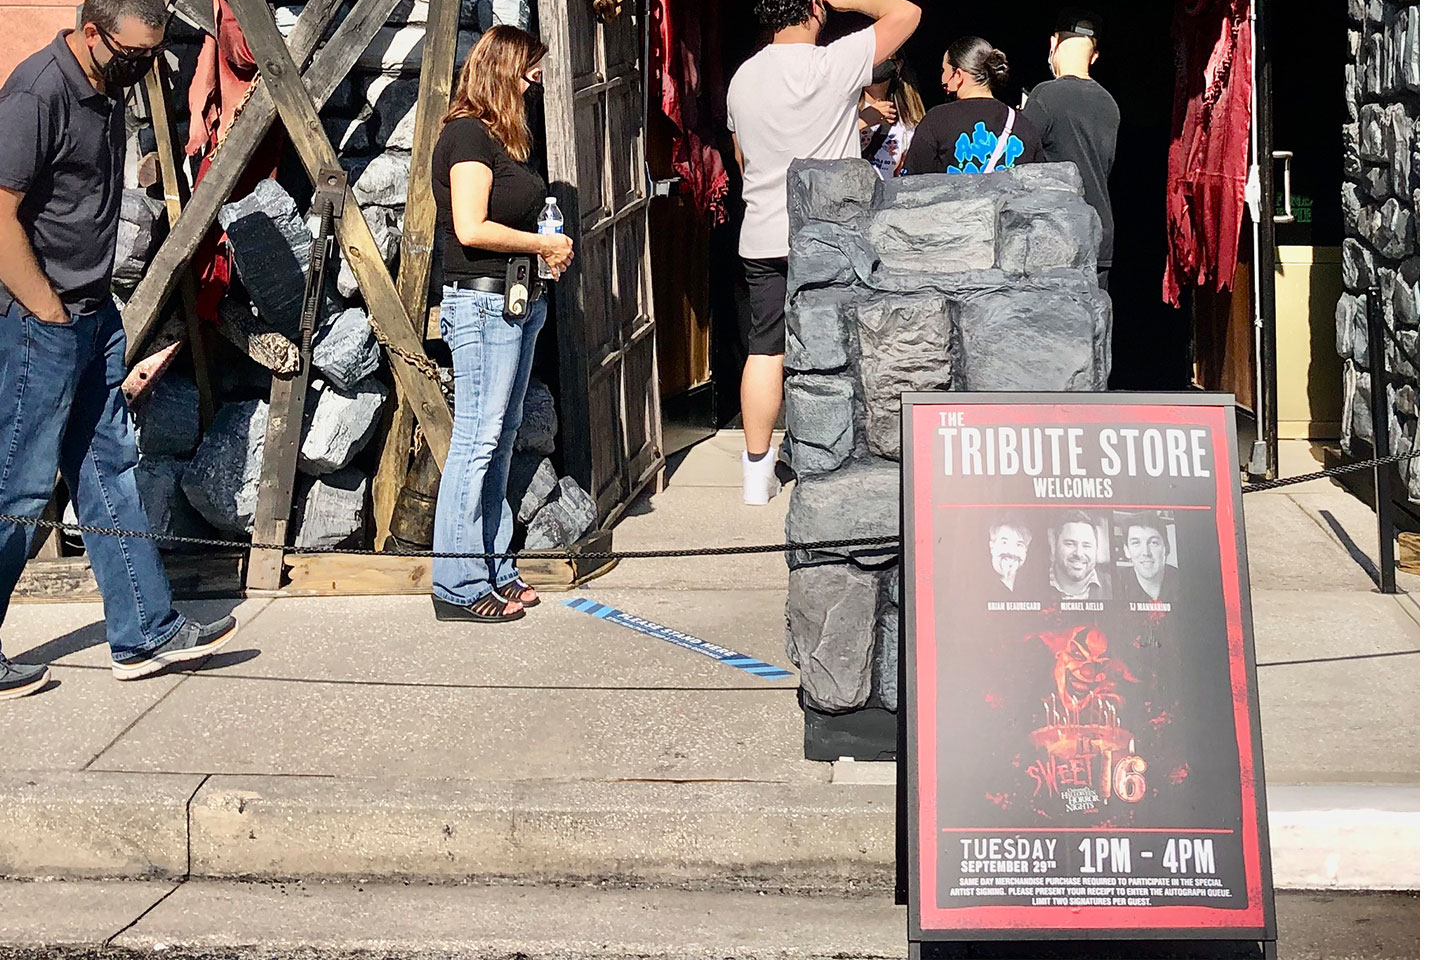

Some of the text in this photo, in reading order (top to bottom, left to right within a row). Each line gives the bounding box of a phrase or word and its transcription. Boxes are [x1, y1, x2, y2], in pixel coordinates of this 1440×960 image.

[938, 412, 965, 427] THE
[938, 428, 1211, 478] TRIBUTE STORE
[1033, 478, 1113, 499] WELCOMES
[1060, 602, 1104, 611] MICHAEL AIELLO
[1129, 602, 1137, 611] TJ
[617, 613, 738, 657] PLEASE STAND HERE
[1025, 749, 1147, 804] SWEET 16
[960, 838, 1057, 860] TUESDAY
[1078, 838, 1132, 873] 1PM
[1162, 838, 1216, 874] 4PM
[960, 860, 1057, 873] SEPTEMBER 29TH
[959, 877, 1223, 887] SAME DAY MERCHANDISE PURCHASE REQUIRED TO PARTICIPATE IN THE SPECIAL
[950, 888, 975, 896] ARTIST
[975, 888, 1007, 896] SIGNING.
[1008, 888, 1034, 896] PLEASE
[1035, 888, 1065, 896] PRESENT
[1067, 888, 1086, 896] YOUR
[1087, 888, 1115, 896] RECEIPT
[1116, 888, 1126, 896] TO
[1127, 888, 1149, 896] ENTER
[1150, 888, 1163, 896] THE
[1207, 889, 1232, 897] QUEUE.
[1032, 897, 1152, 906] LIMIT TWO SIGNATURES PER GUEST.
